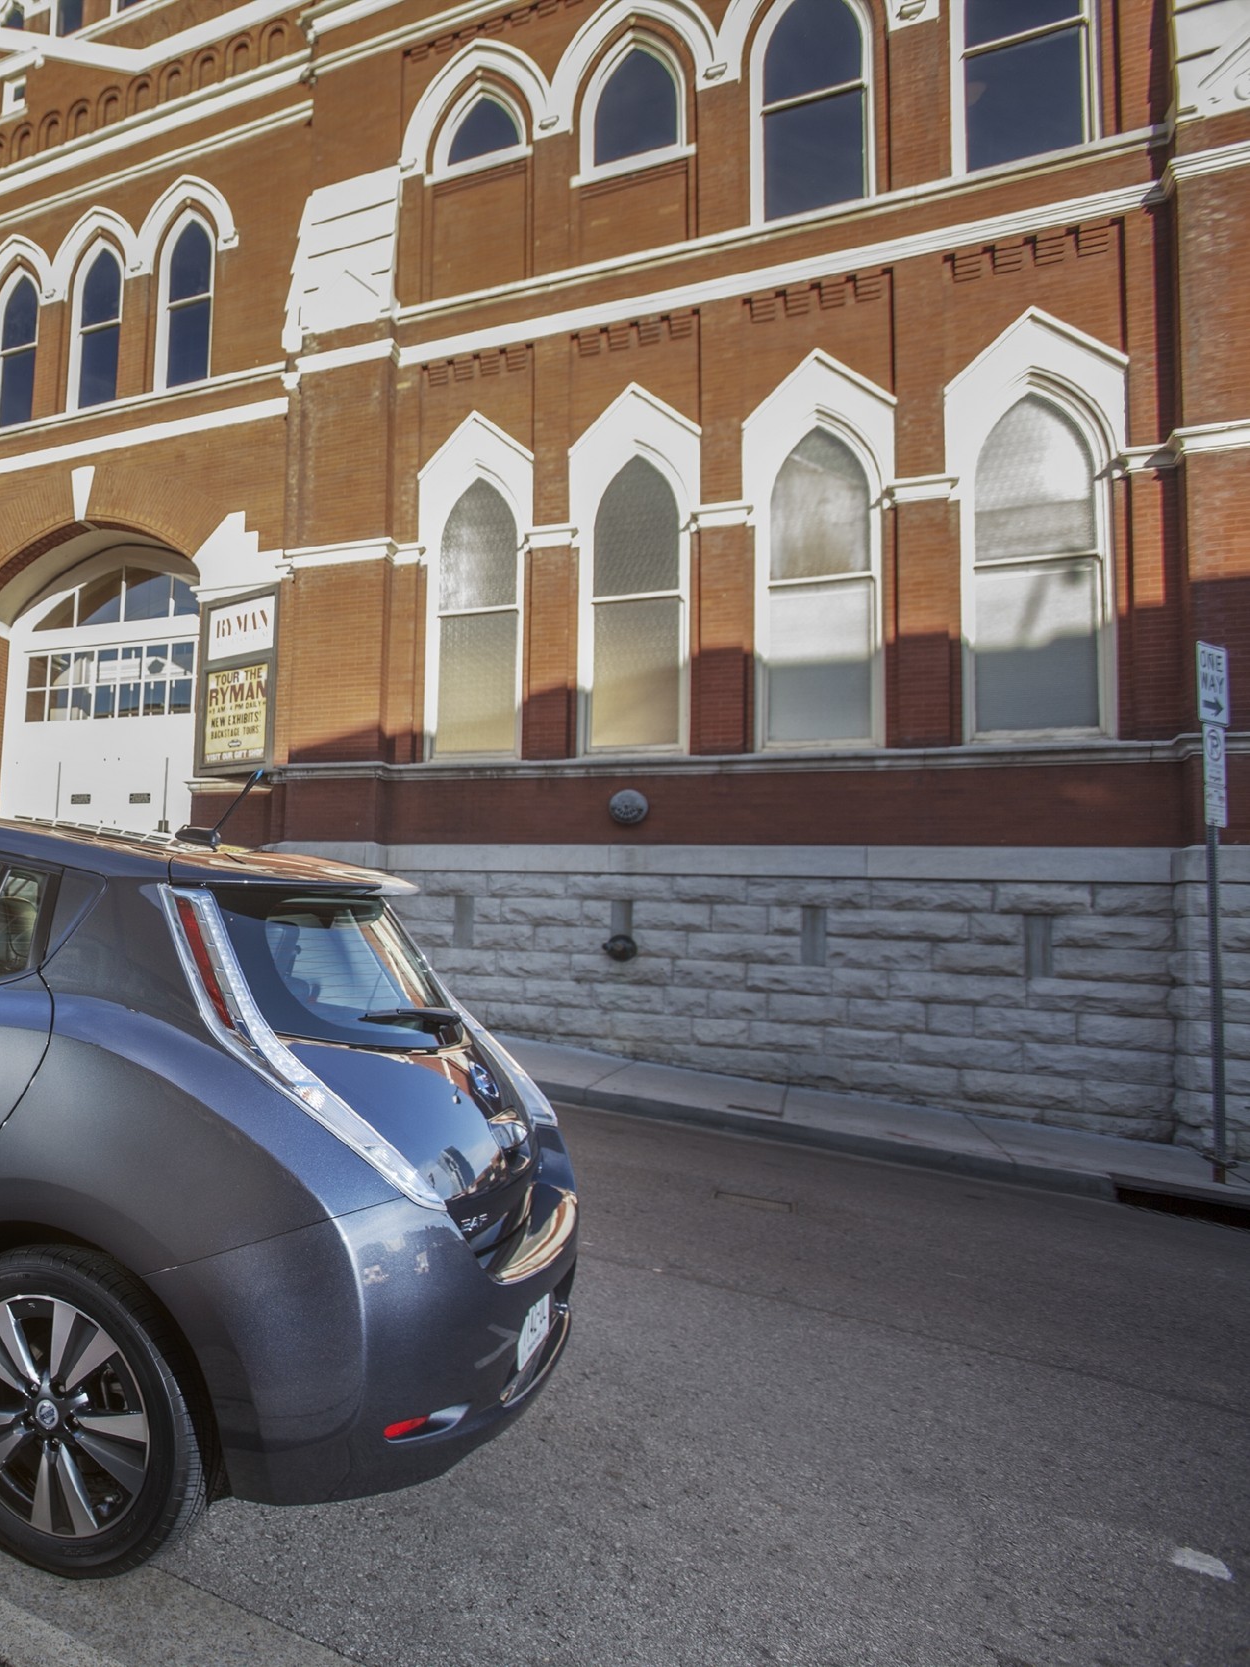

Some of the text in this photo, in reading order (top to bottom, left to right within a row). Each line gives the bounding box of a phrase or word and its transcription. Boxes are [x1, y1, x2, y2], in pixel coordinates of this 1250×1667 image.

[216, 609, 268, 639] RYMAN
[1200, 650, 1224, 673] ONE
[215, 667, 263, 687] TOUR THE
[1200, 671, 1225, 695] WAY
[209, 680, 267, 707] RYMAN
[211, 716, 226, 728] NEW
[211, 727, 240, 740] BACKSTAGE
